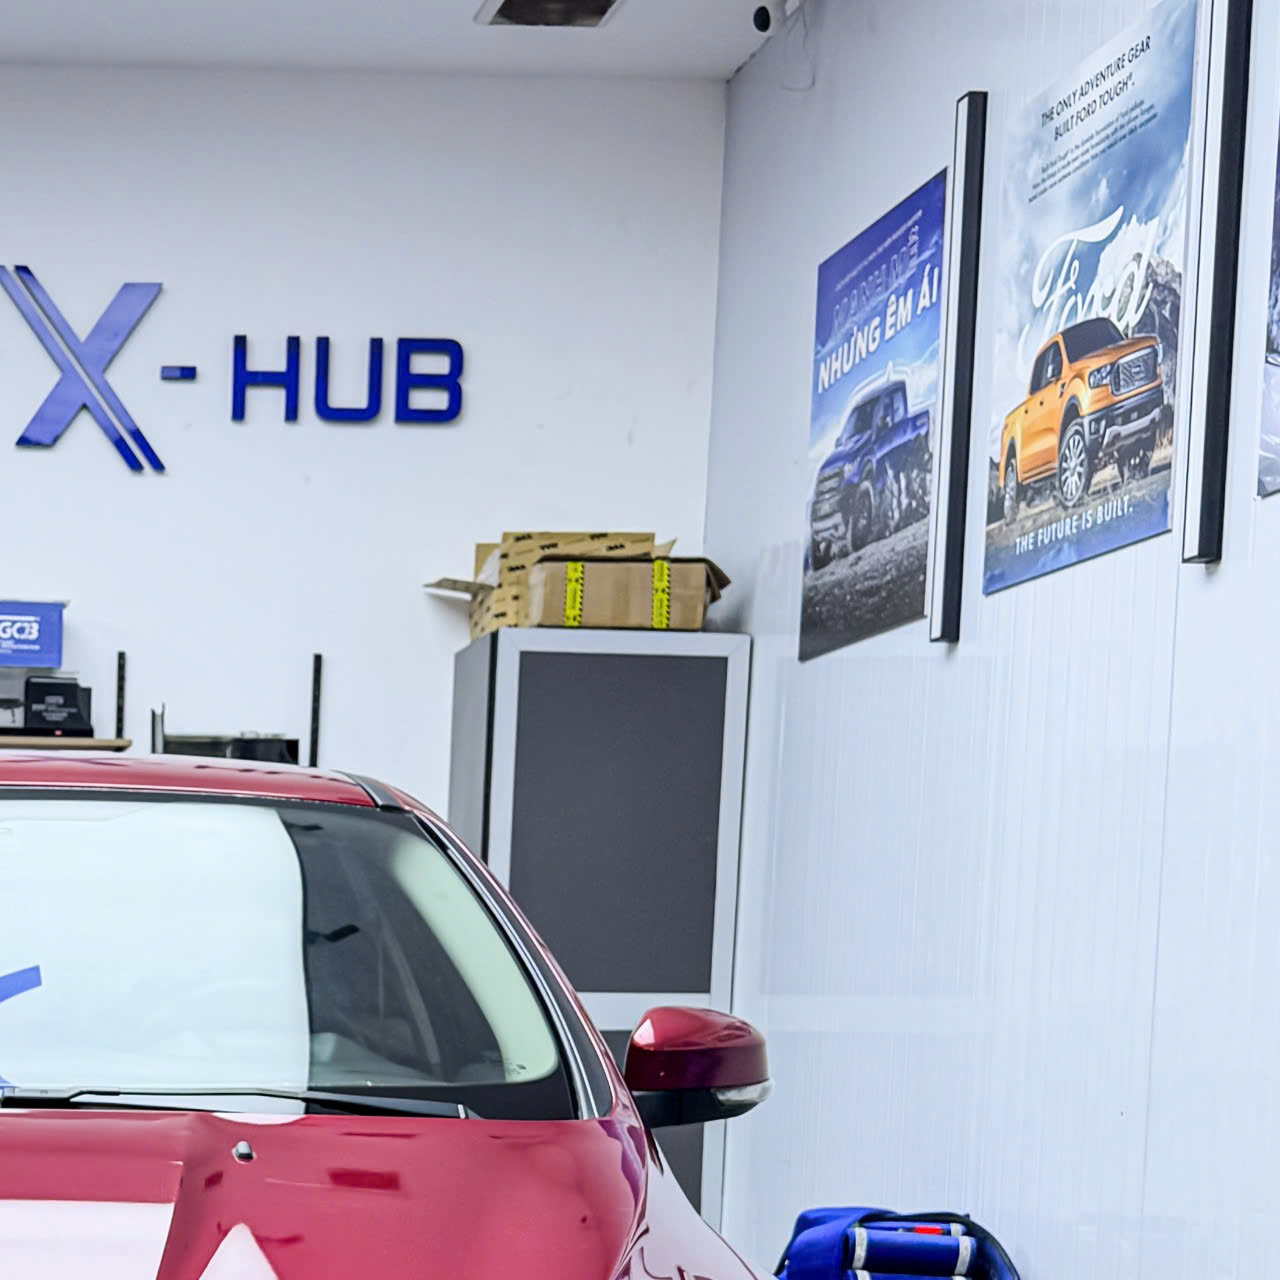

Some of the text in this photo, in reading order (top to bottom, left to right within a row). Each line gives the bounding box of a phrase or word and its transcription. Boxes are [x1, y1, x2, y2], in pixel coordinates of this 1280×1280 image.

[1041, 35, 1151, 128] THE ONLY ADVENTURE GEAR
[1075, 99, 1097, 126] FORD
[884, 293, 914, 341] ÊM
[917, 263, 939, 315] ÁI
[231, 335, 465, 424] HUB
[1015, 532, 1035, 555] THE
[1037, 515, 1078, 547] FUTURE
[1081, 510, 1093, 530] IS
